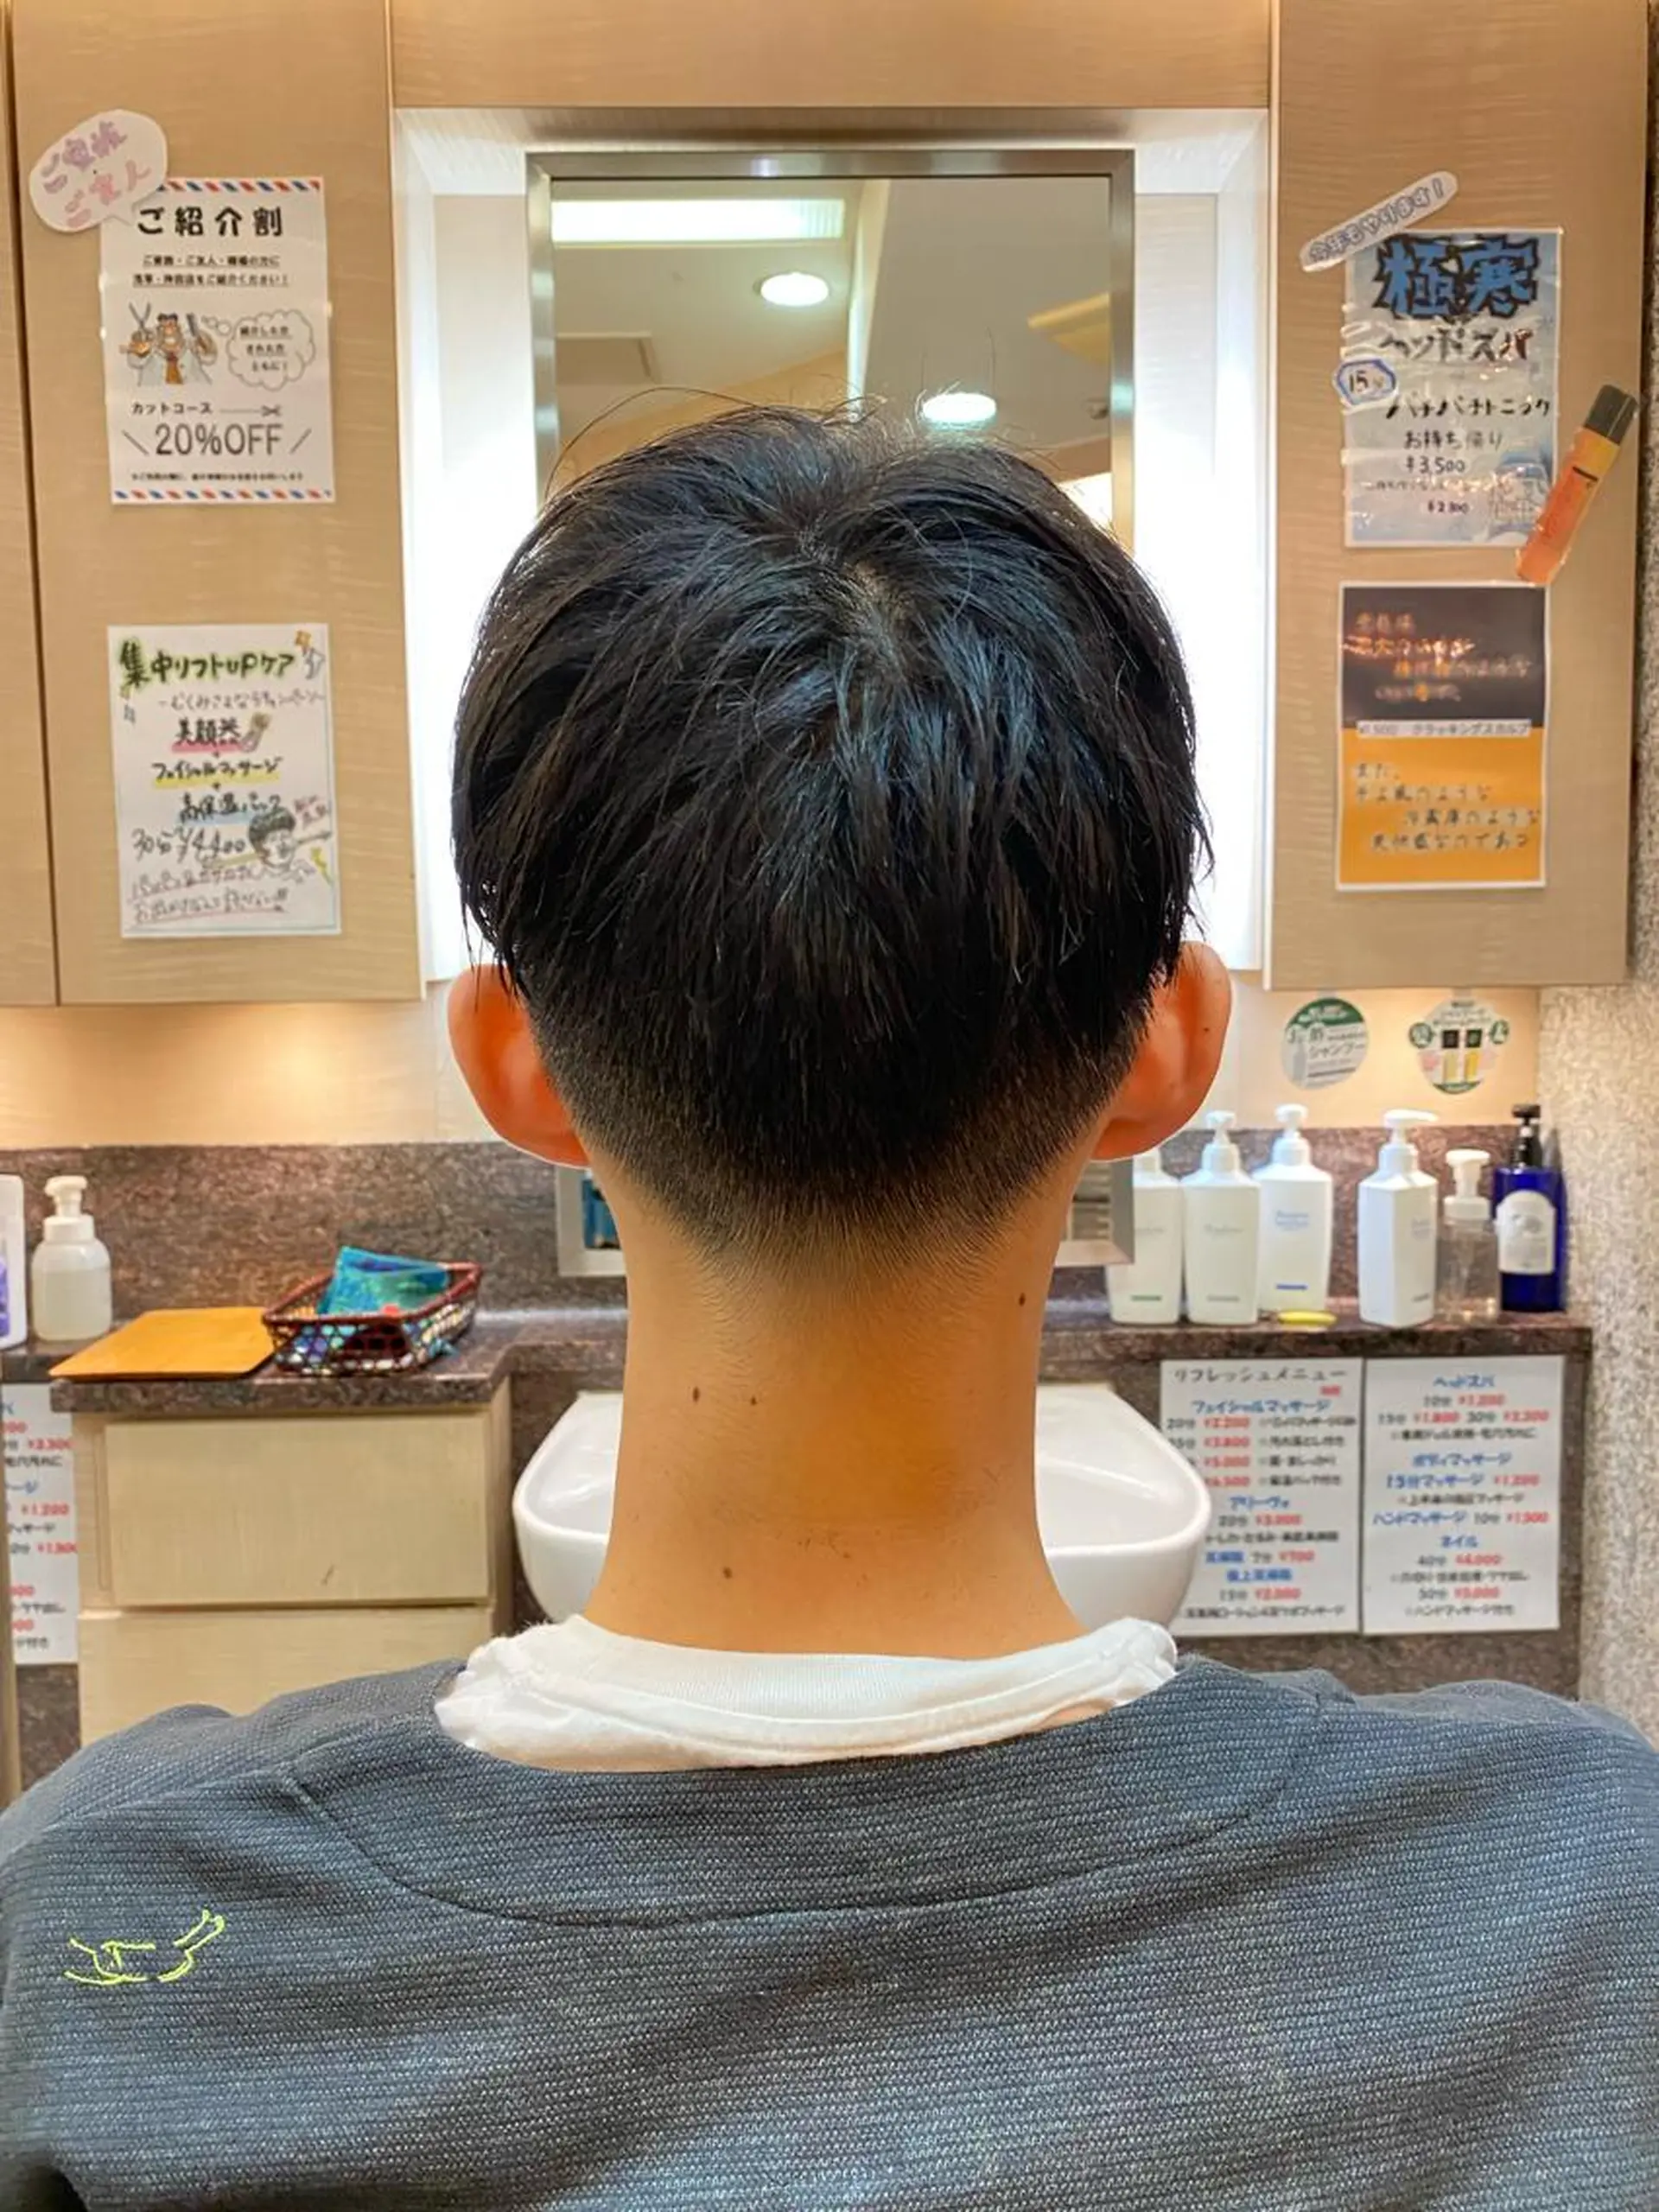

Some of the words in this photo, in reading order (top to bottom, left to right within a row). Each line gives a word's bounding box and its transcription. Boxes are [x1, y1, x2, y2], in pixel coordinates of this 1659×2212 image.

[137, 205, 283, 238] ご紹介割
[1372, 232, 1539, 322] 極寒
[1379, 326, 1535, 363] ヘッドスパ
[131, 401, 213, 416] カットコース
[155, 423, 283, 455] 20%OFF
[1174, 1367, 1348, 1382] リフレッシュメニュー
